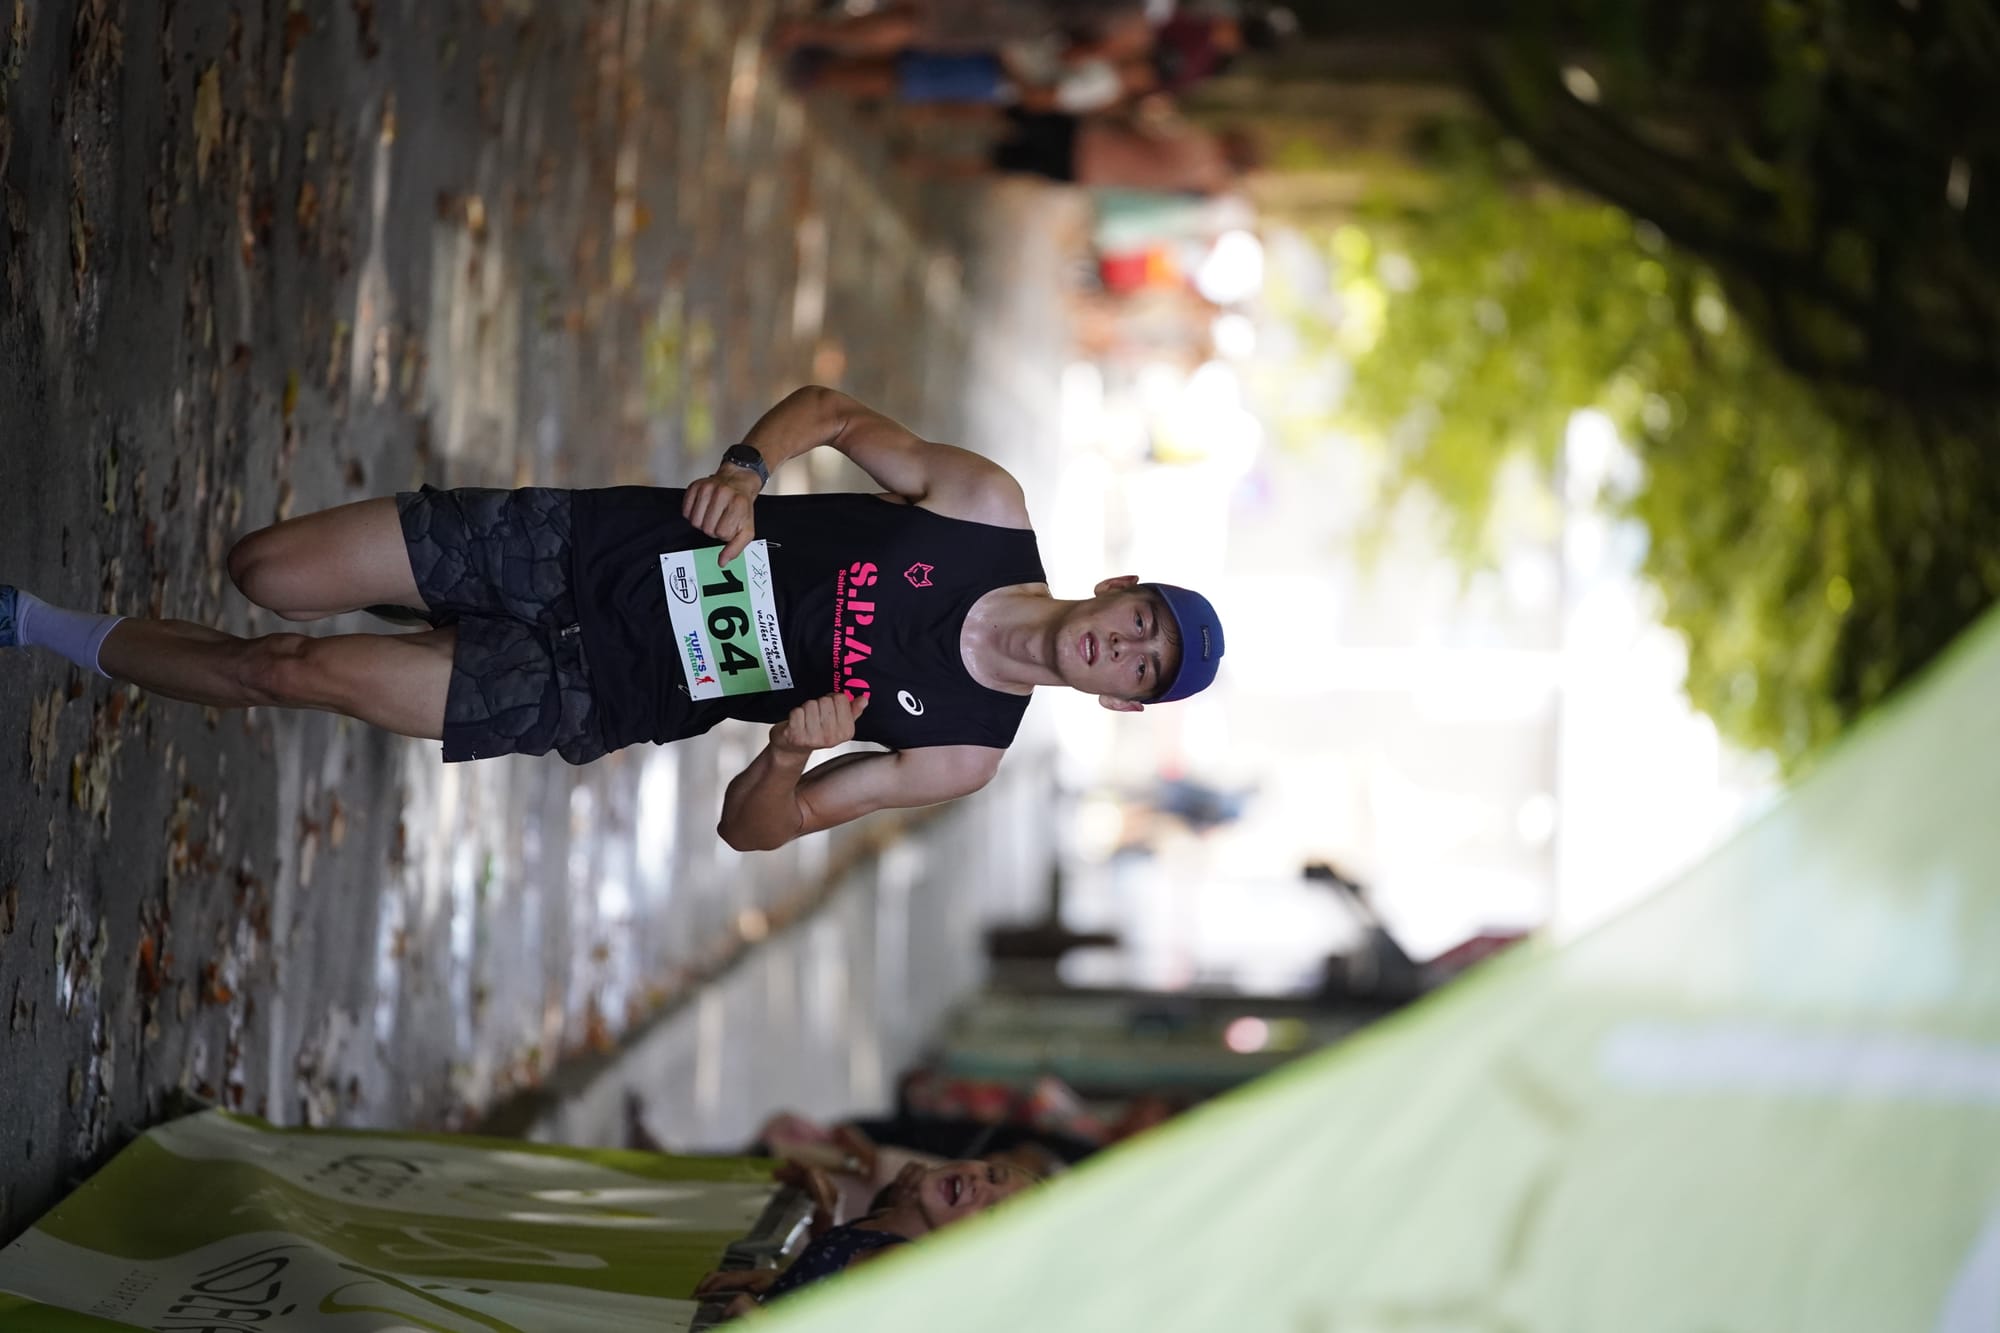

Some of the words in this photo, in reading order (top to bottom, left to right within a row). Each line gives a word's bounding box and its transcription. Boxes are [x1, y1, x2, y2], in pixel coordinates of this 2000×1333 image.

[676, 566, 689, 599] BFP
[836, 569, 847, 596] Saint
[702, 569, 760, 676] 164
[834, 598, 844, 627] Privat
[683, 635, 700, 677] Aventure
[689, 630, 707, 673] TUFF'S
[766, 613, 781, 660] Challenge
[777, 664, 787, 679] des
